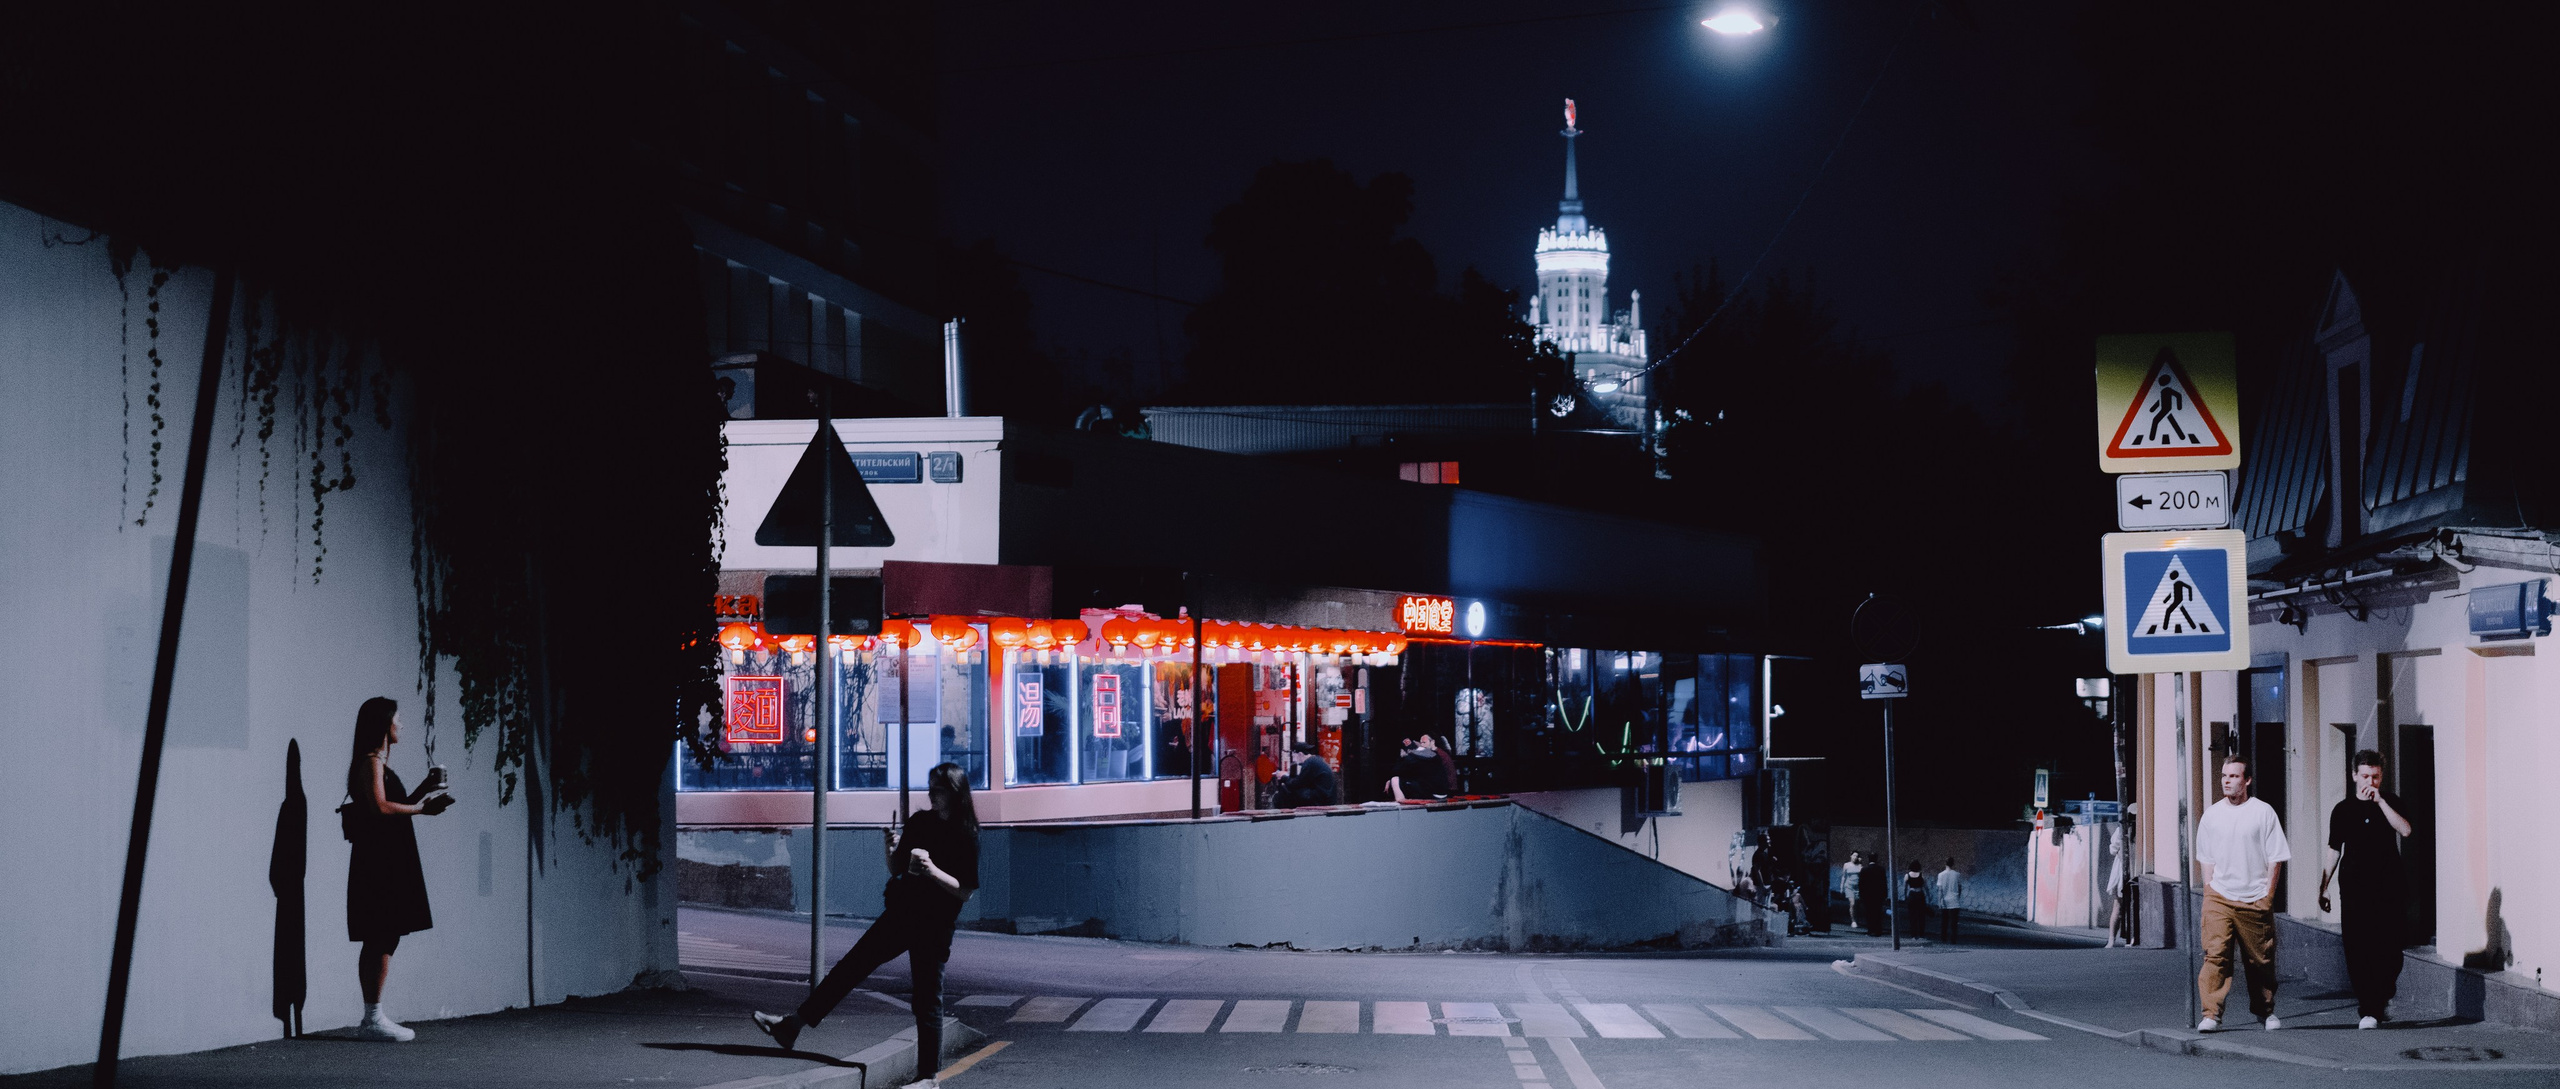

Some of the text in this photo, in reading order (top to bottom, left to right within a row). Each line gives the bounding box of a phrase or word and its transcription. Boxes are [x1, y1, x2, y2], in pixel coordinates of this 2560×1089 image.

[853, 457, 911, 467] ТИТЕЛЬСКИЙ
[933, 457, 953, 473] 2/1
[2159, 490, 2200, 510] 200
[1019, 682, 1041, 729] 湯
